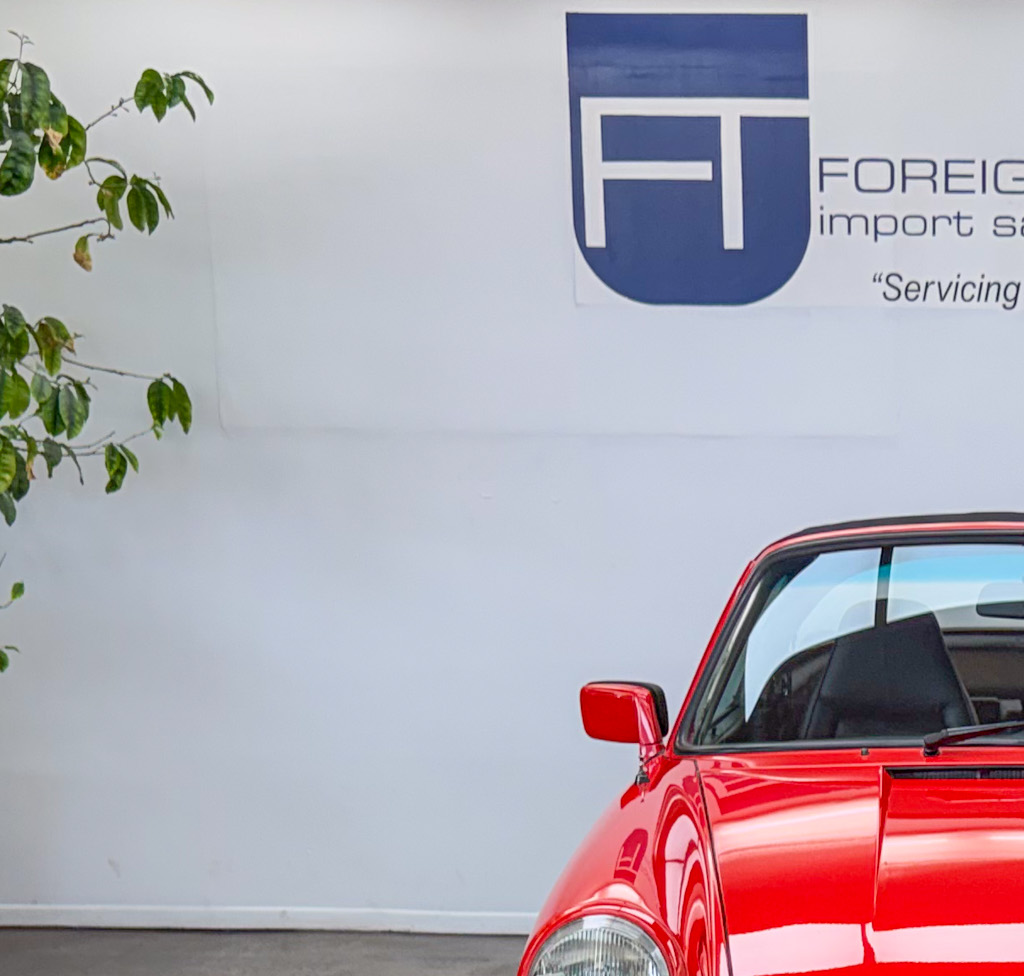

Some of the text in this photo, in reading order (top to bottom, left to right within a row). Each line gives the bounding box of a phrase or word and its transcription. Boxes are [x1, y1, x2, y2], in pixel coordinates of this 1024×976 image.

[580, 97, 810, 250] FT
[819, 206, 974, 243] import
[872, 272, 1021, 311] “Servicing
